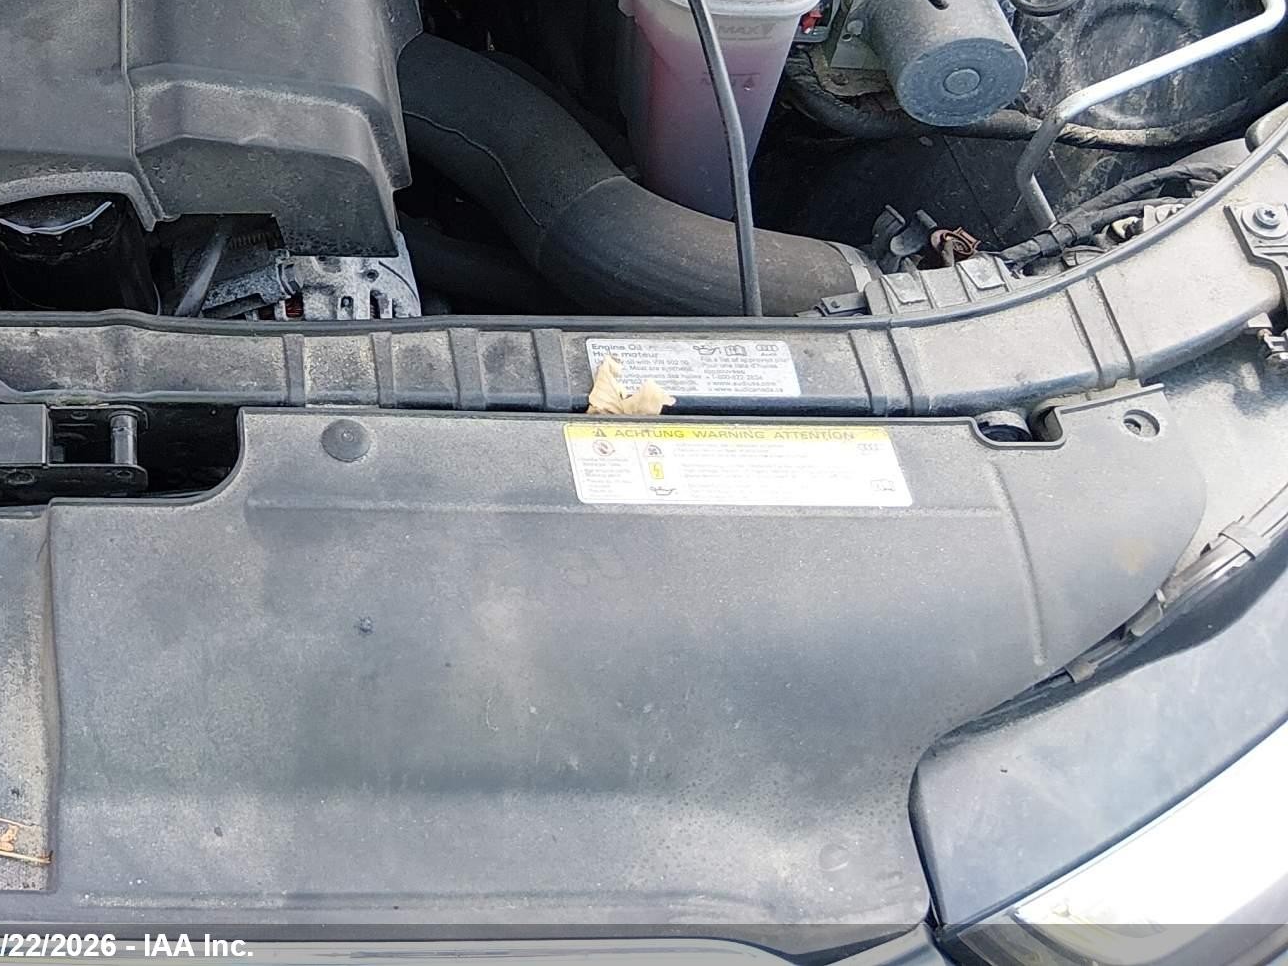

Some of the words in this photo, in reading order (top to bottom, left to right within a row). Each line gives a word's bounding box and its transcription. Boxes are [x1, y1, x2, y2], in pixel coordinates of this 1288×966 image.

[591, 343, 625, 352] Engine
[628, 343, 642, 351] Oil
[614, 429, 685, 439] ACHTUNG
[692, 430, 765, 440] WARNING
[774, 431, 855, 441] ATTENTION
